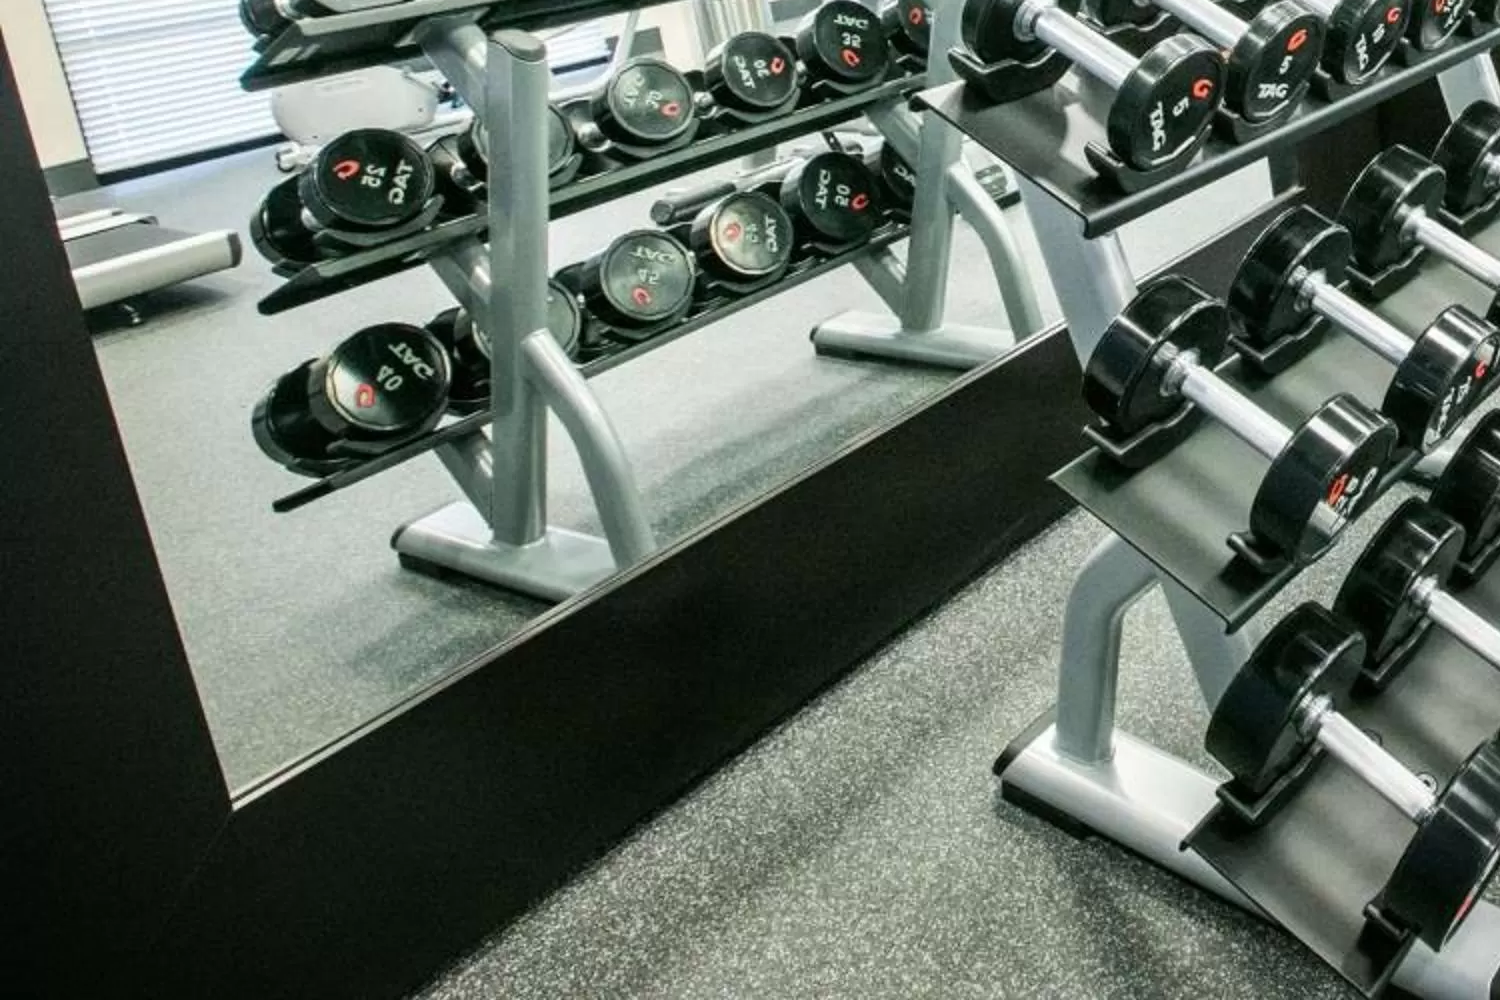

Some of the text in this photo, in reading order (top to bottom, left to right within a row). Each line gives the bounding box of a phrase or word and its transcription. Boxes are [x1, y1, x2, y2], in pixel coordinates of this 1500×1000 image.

[1279, 55, 1294, 75] 5
[1256, 82, 1289, 99] TAG
[1171, 95, 1190, 117] 5
[1150, 101, 1168, 152] TAG
